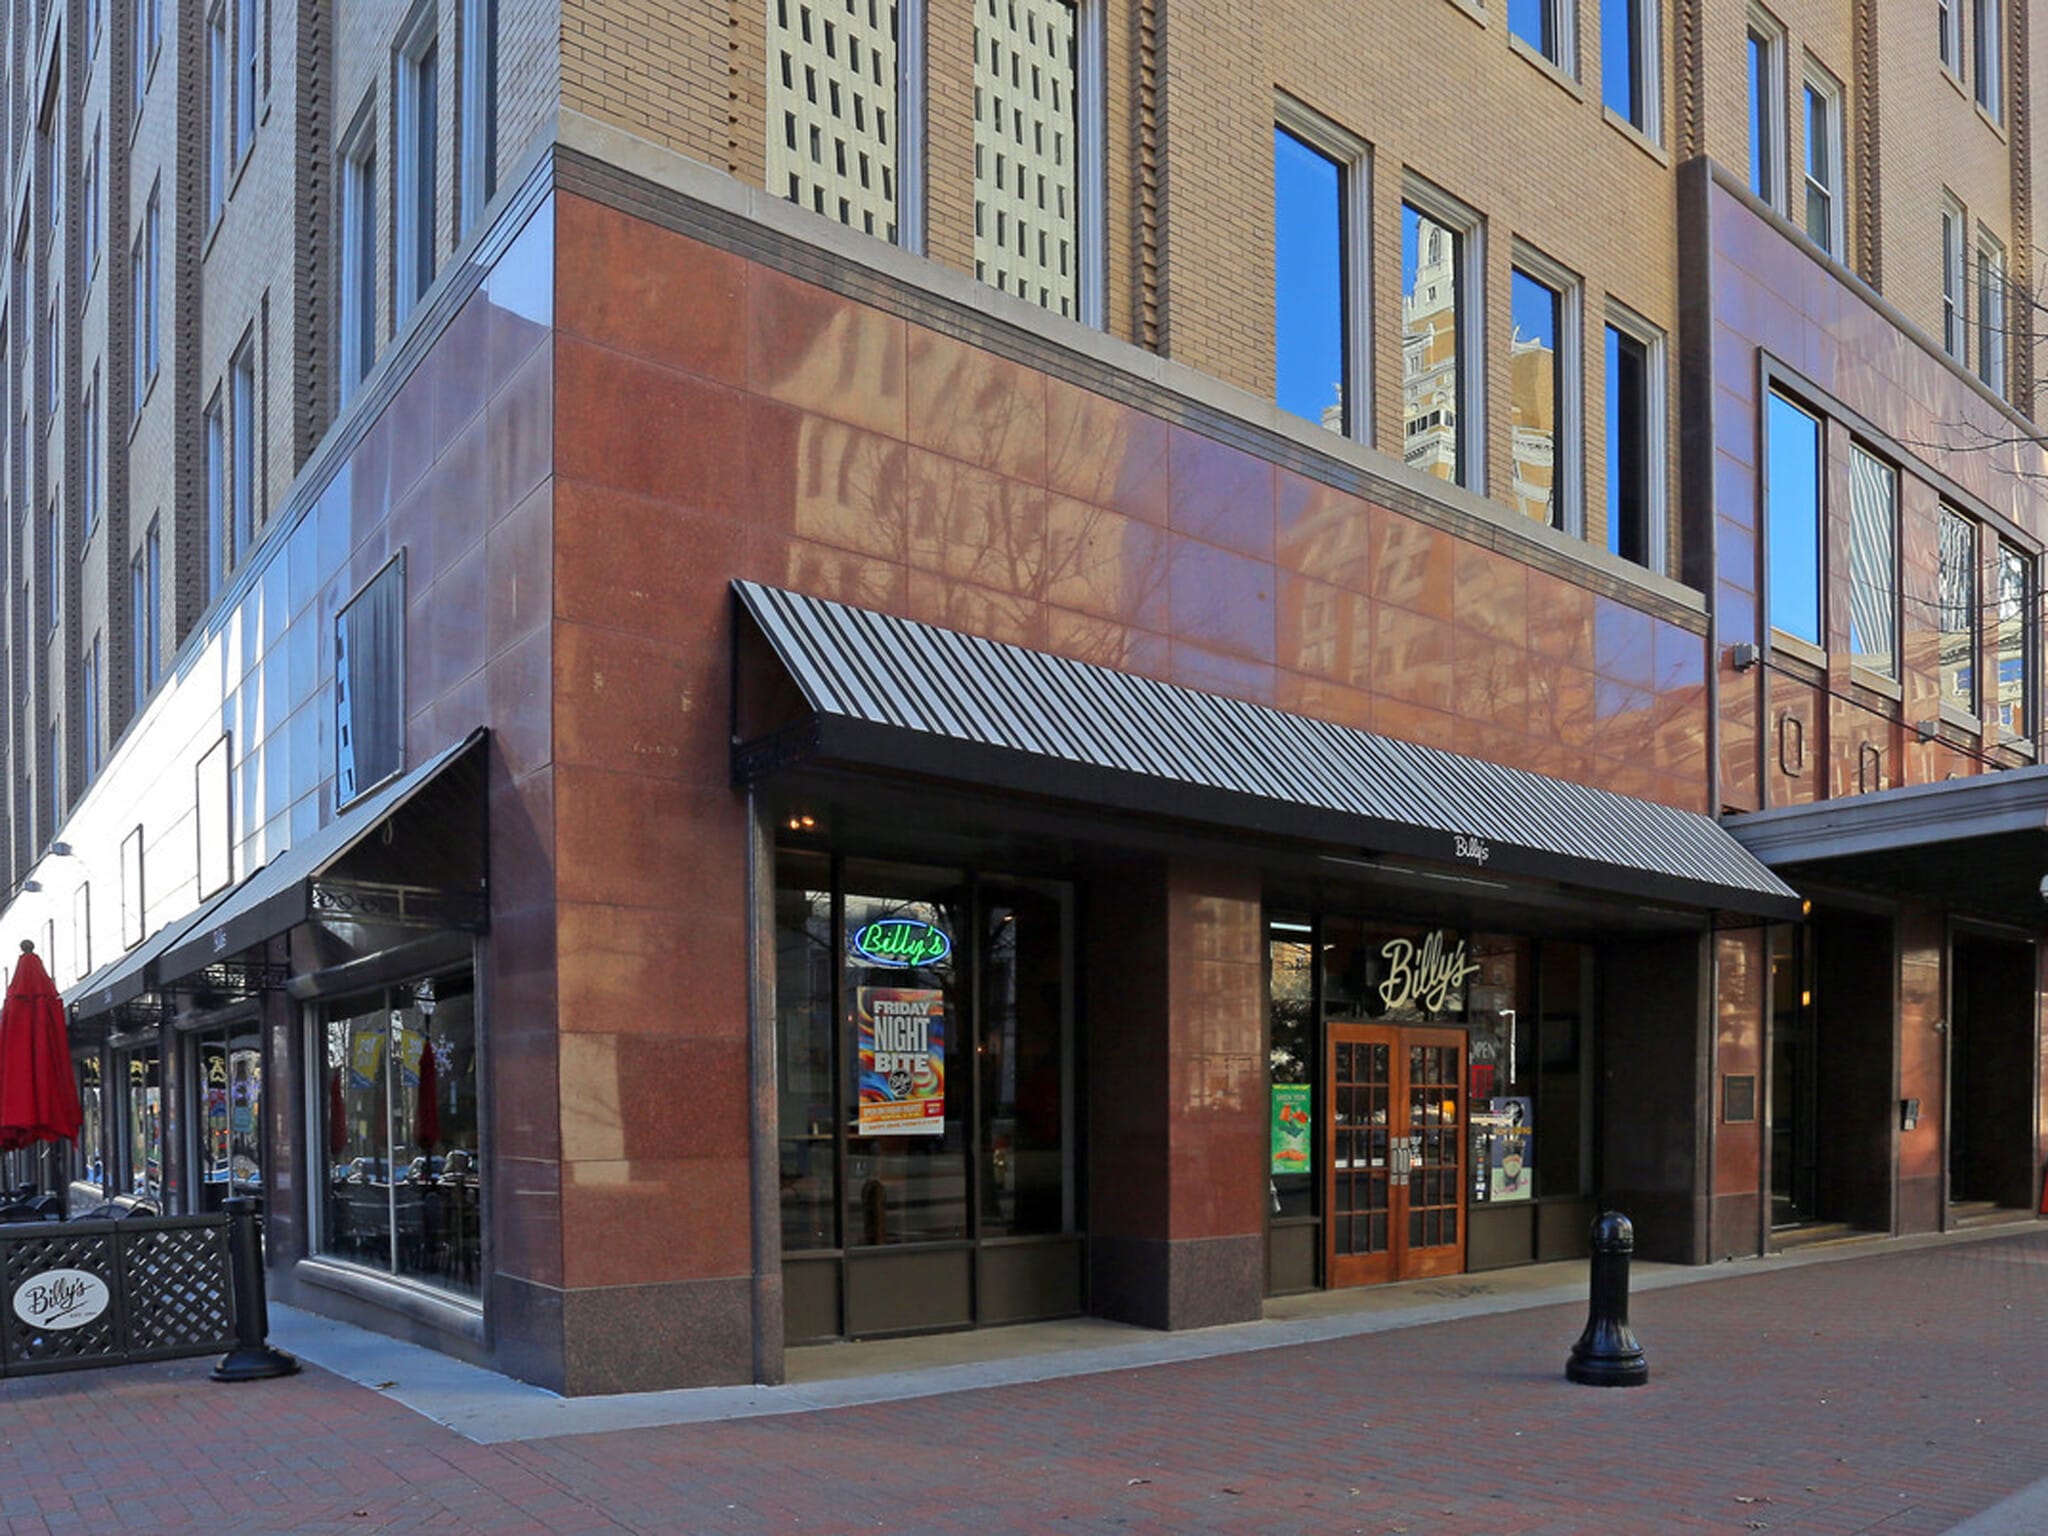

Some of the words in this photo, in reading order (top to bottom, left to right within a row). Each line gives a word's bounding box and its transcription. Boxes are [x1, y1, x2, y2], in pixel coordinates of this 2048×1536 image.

[1453, 835, 1489, 866] Billy's
[863, 924, 944, 965] Billy's
[1379, 930, 1480, 1012] Billy's
[874, 1001, 930, 1015] FRIDAY
[874, 1016, 930, 1051] NIGHT
[874, 1053, 929, 1073] BITE
[25, 1277, 96, 1315] Billy's
